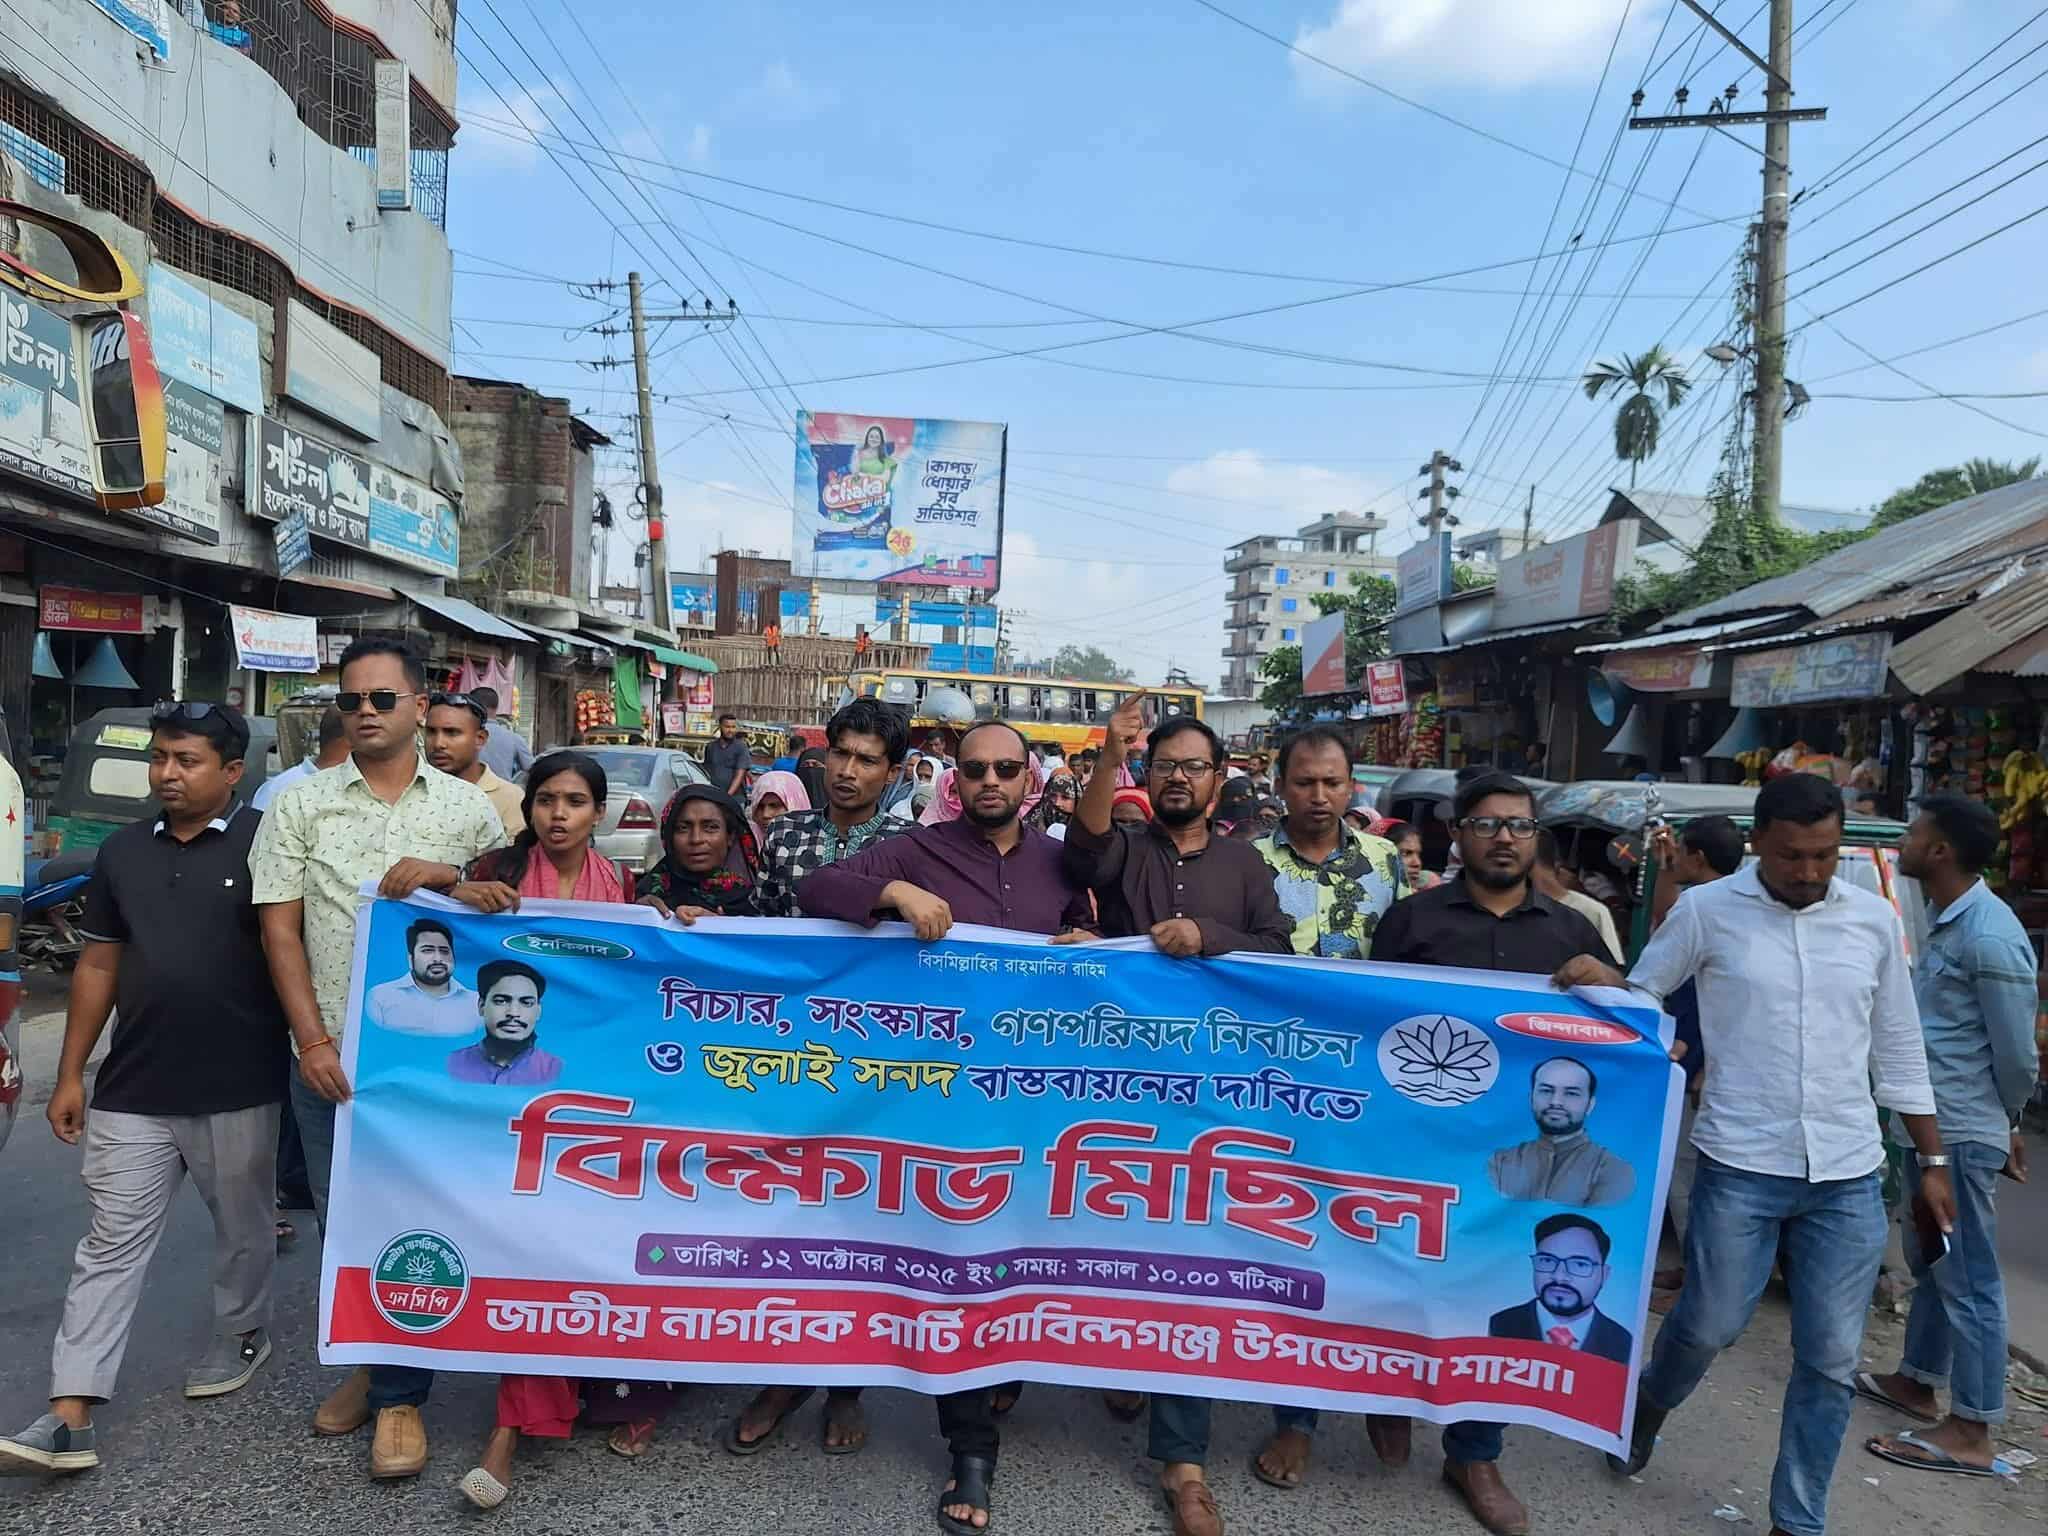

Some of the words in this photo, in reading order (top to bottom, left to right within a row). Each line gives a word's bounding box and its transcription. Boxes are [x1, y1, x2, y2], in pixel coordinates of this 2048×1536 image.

[929, 459, 975, 478] কাপড়
[823, 474, 886, 505] Chaka
[924, 474, 972, 492] ধোয়ার
[936, 490, 960, 506] সব
[319, 509, 328, 527] ও
[915, 505, 979, 525] সলিউশন
[526, 935, 609, 959] ইনকিলাব
[657, 975, 793, 1036] বিচার,
[805, 995, 976, 1049] সংস্কার,
[992, 1002, 1200, 1054] গণপরিষদ
[1204, 1006, 1363, 1068] নির্বাচন
[1527, 1016, 1612, 1039] জিন্দাবাদ
[646, 1041, 686, 1075] ও
[700, 1040, 843, 1093] জুলাই
[849, 1056, 961, 1098] সনদ
[965, 1064, 1206, 1106] বাস্তবায়নের
[1212, 1066, 1371, 1122] দাবিতে
[508, 1090, 1026, 1225] বিক্ষোভ
[1043, 1118, 1460, 1262] মিছিল
[760, 1248, 793, 1272] ১২
[800, 1246, 887, 1273] অক্টোবর
[895, 1257, 958, 1286] ২০২৫
[1076, 1258, 1140, 1281] সকাল
[1147, 1262, 1221, 1288] ১০.০০
[485, 1290, 651, 1344] জাতীয়
[661, 1296, 857, 1347] নাগরিক
[867, 1307, 966, 1354] পার্টি
[974, 1301, 1222, 1364] গোবিন্দগঞ্জ
[1232, 1320, 1444, 1386] উপজেলা
